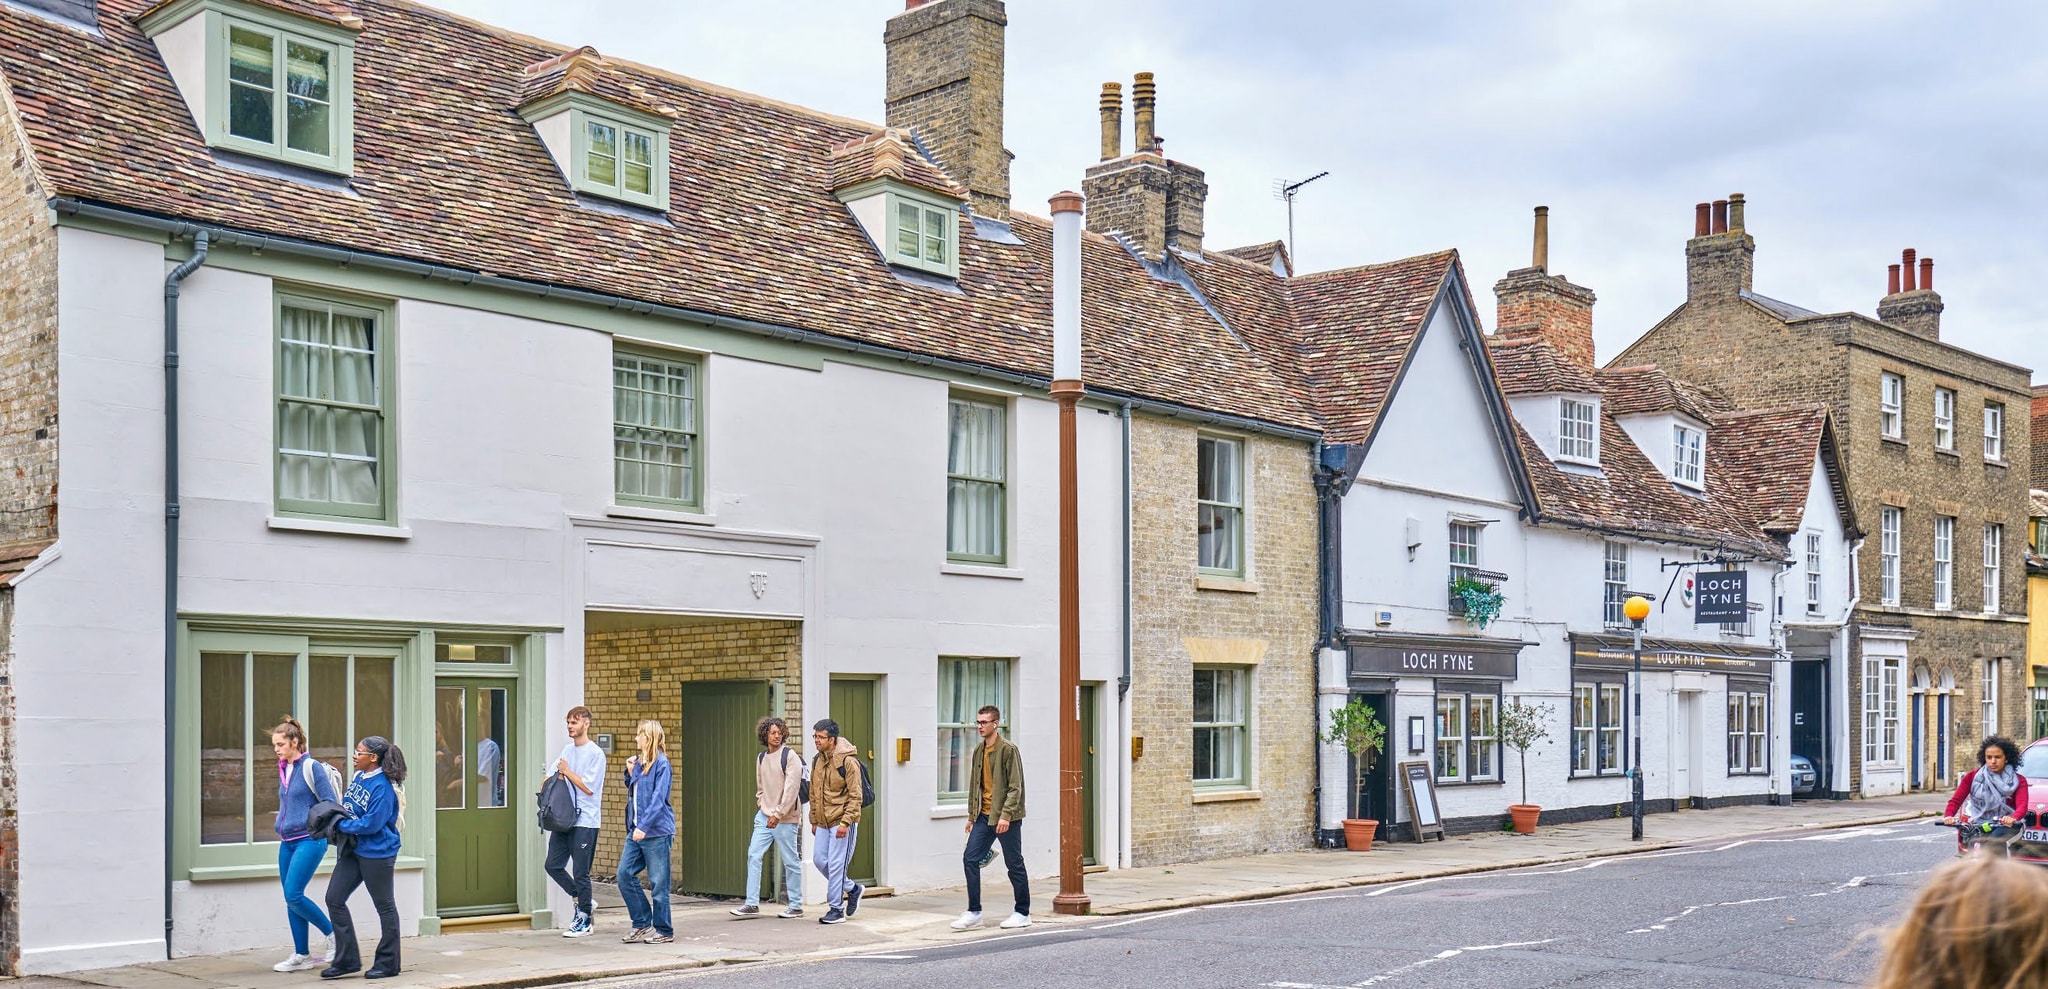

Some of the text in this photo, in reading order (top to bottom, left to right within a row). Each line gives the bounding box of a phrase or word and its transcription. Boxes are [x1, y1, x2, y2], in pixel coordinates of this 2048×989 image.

[1700, 579, 1741, 591] LOCH
[1700, 593, 1741, 605] FYNE
[1403, 652, 1474, 671] LOCH FYNE
[1656, 653, 1681, 665] LOCH
[344, 782, 371, 812] ALE
